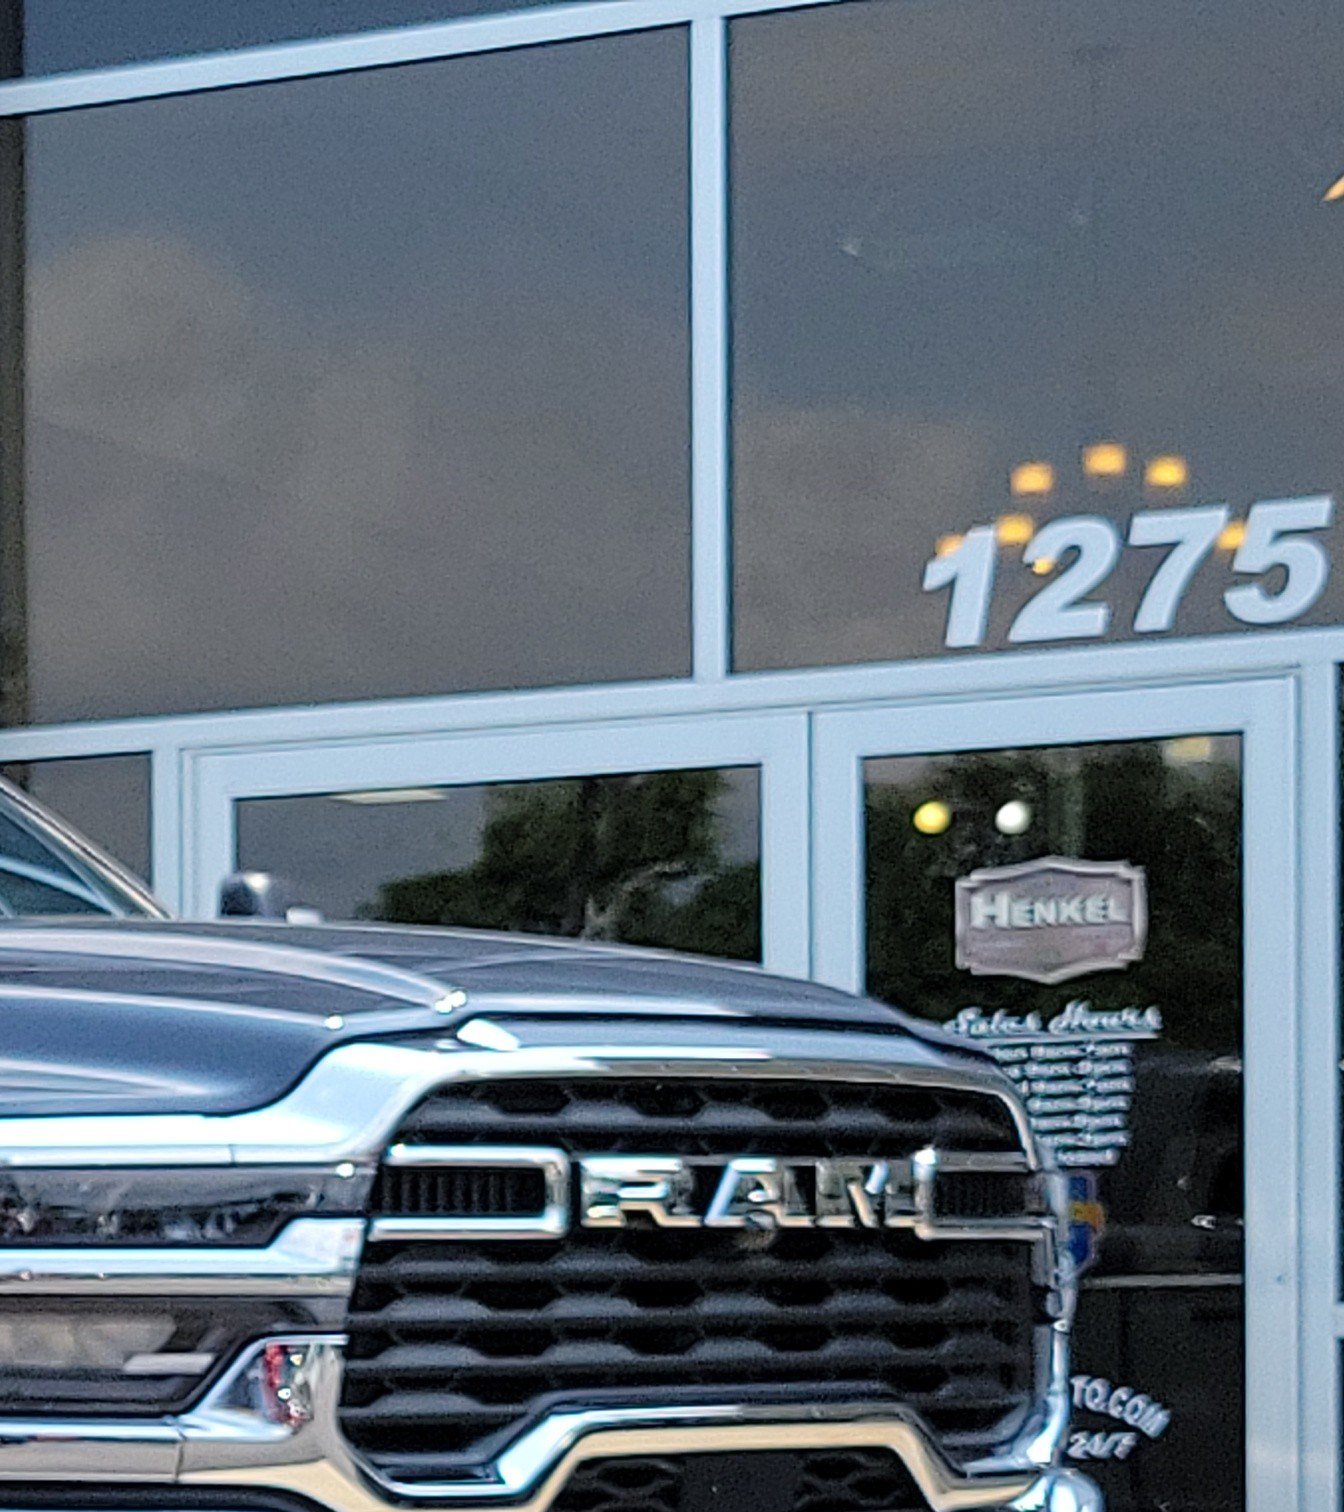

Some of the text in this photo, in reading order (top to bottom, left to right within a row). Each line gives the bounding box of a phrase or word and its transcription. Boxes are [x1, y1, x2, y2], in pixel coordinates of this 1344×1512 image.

[922, 494, 1334, 648] 1275
[970, 891, 1129, 928] HENKEL
[580, 1156, 928, 1230] RAM
